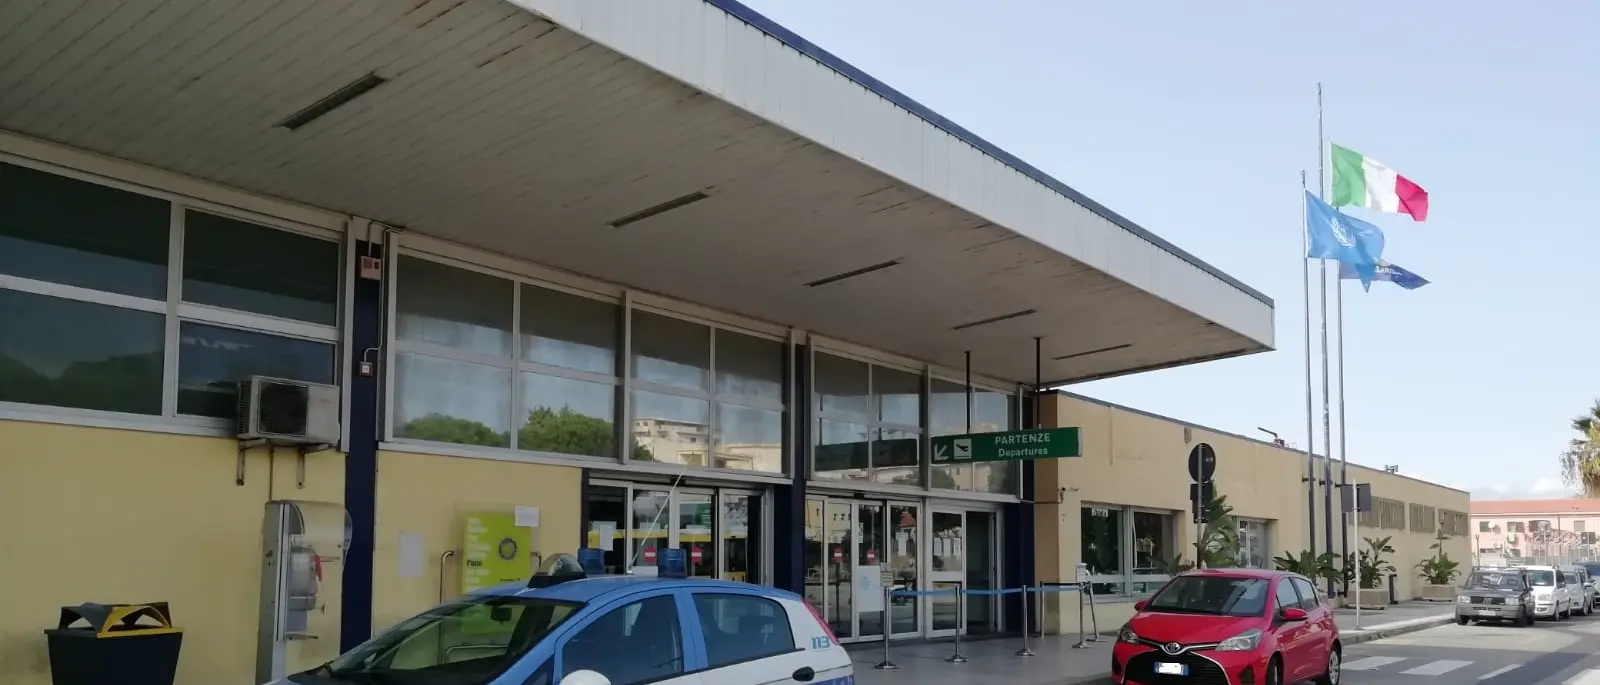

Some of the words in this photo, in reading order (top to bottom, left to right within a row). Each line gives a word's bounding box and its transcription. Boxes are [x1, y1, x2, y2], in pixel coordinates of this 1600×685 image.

[994, 432, 1051, 445] PARTENZE
[998, 447, 1048, 458] Departures
[811, 636, 830, 649] 113
